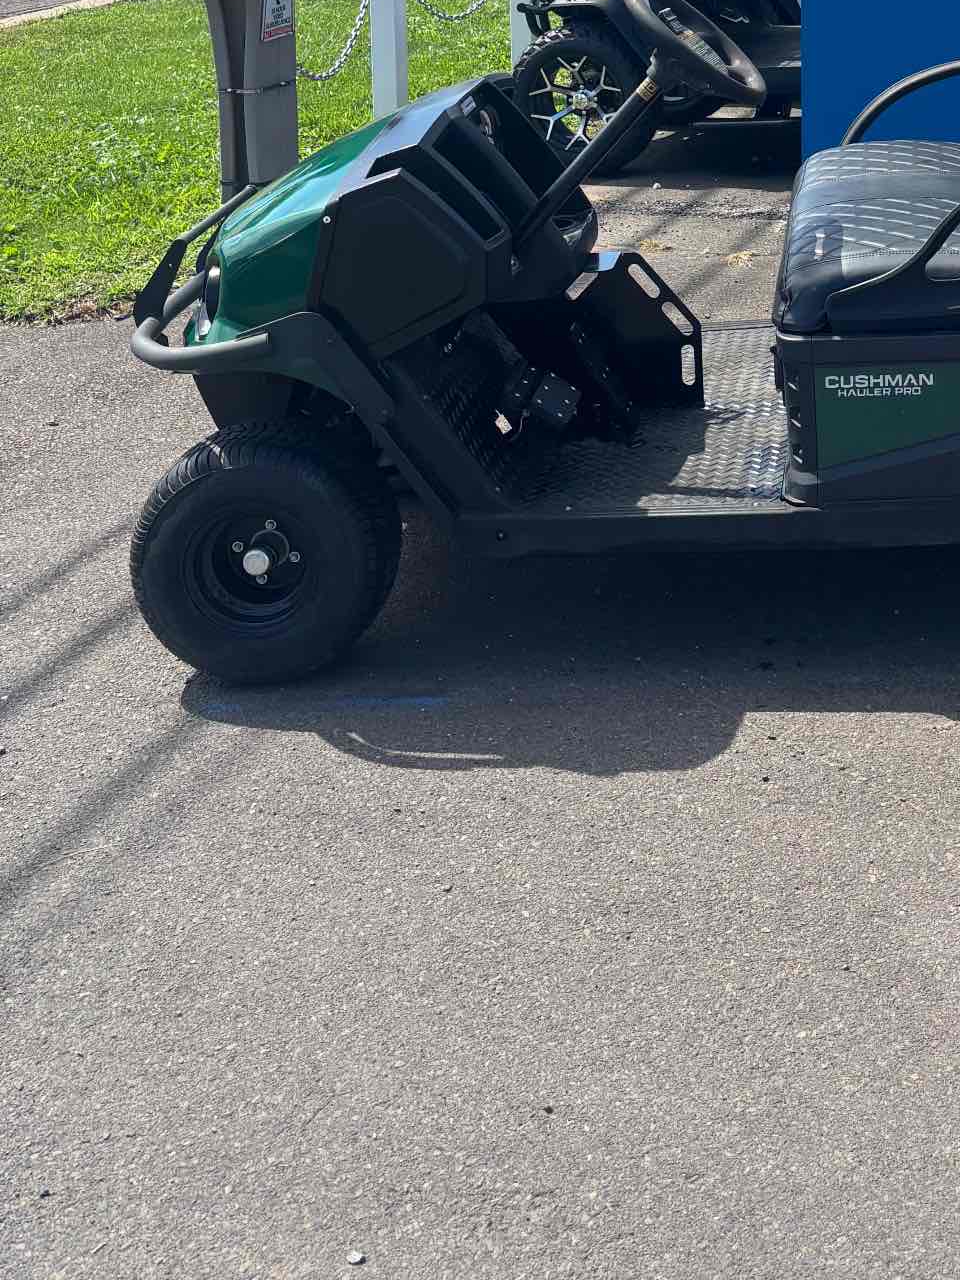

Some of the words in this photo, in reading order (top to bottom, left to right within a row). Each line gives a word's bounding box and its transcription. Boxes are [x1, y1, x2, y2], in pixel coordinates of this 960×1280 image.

[824, 373, 934, 389] CUSHMAN
[838, 387, 891, 398] HAULER
[894, 386, 922, 396] PRO
